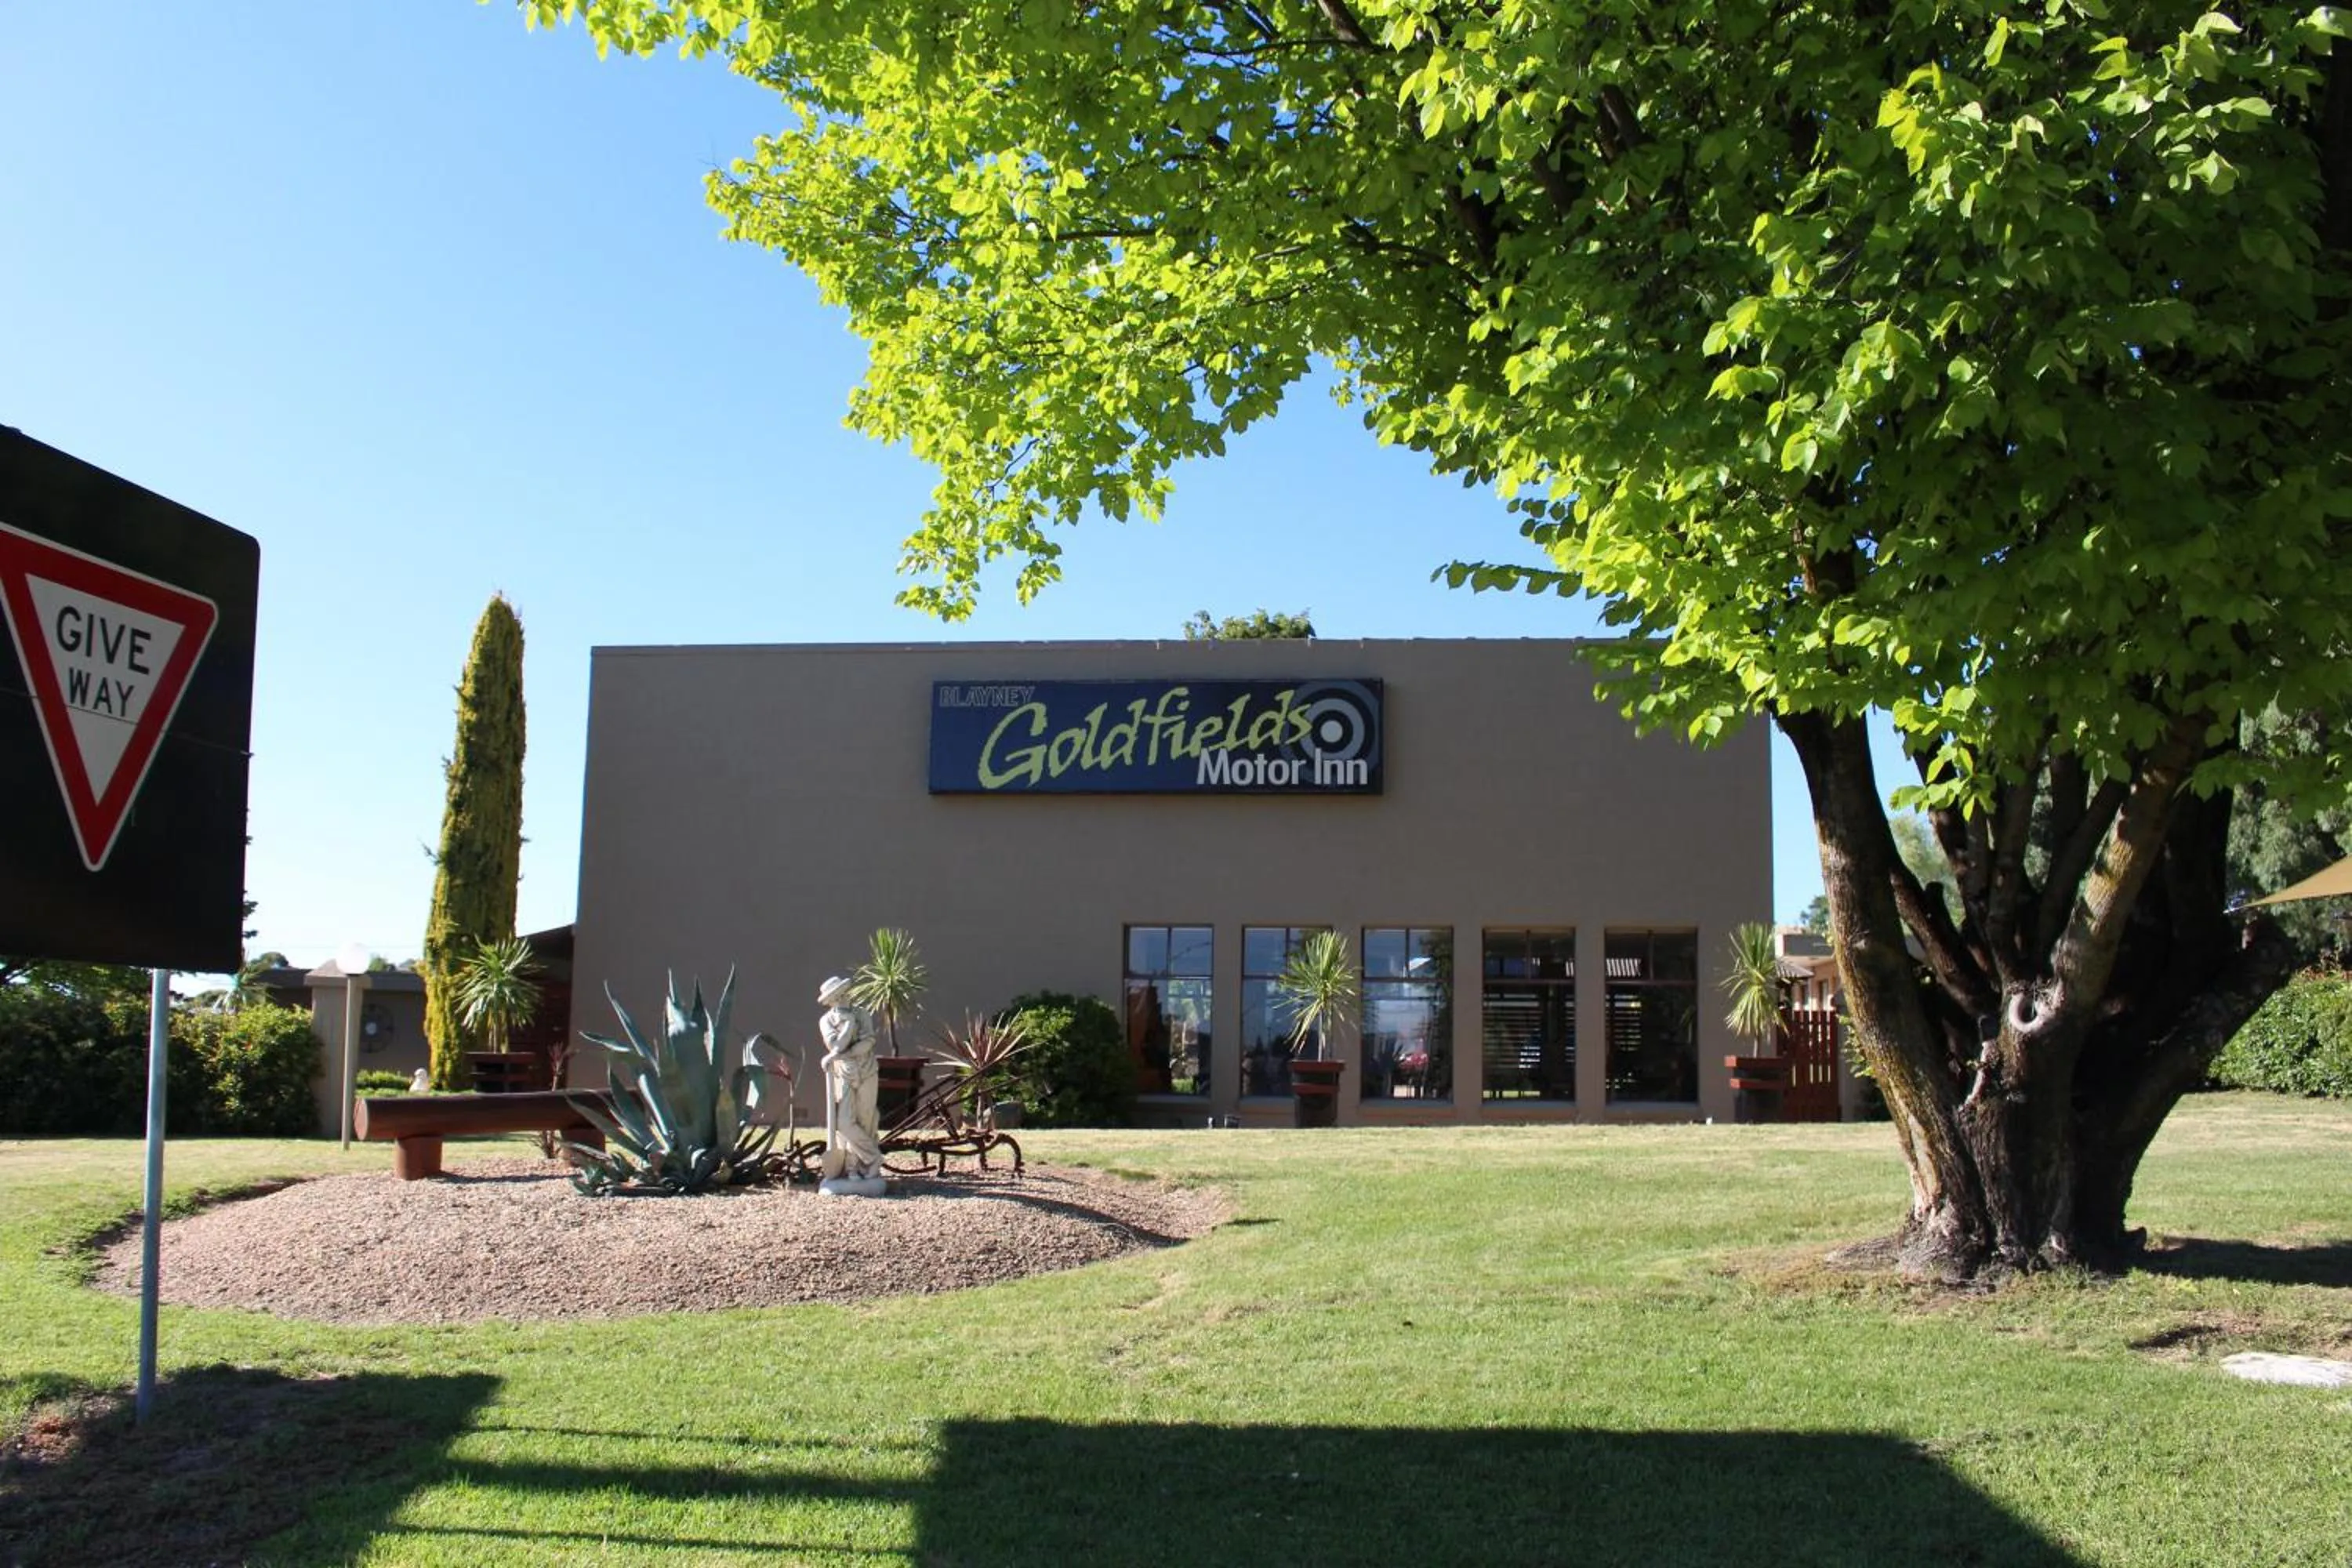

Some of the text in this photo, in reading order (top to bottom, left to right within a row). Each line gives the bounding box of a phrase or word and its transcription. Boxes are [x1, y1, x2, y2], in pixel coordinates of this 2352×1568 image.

[56, 605, 151, 675] GIVE
[69, 667, 134, 717] WAY
[940, 686, 1035, 706] BLAYNEY
[978, 687, 1313, 789] Goldfields
[1196, 747, 1368, 785] Motor Inn
